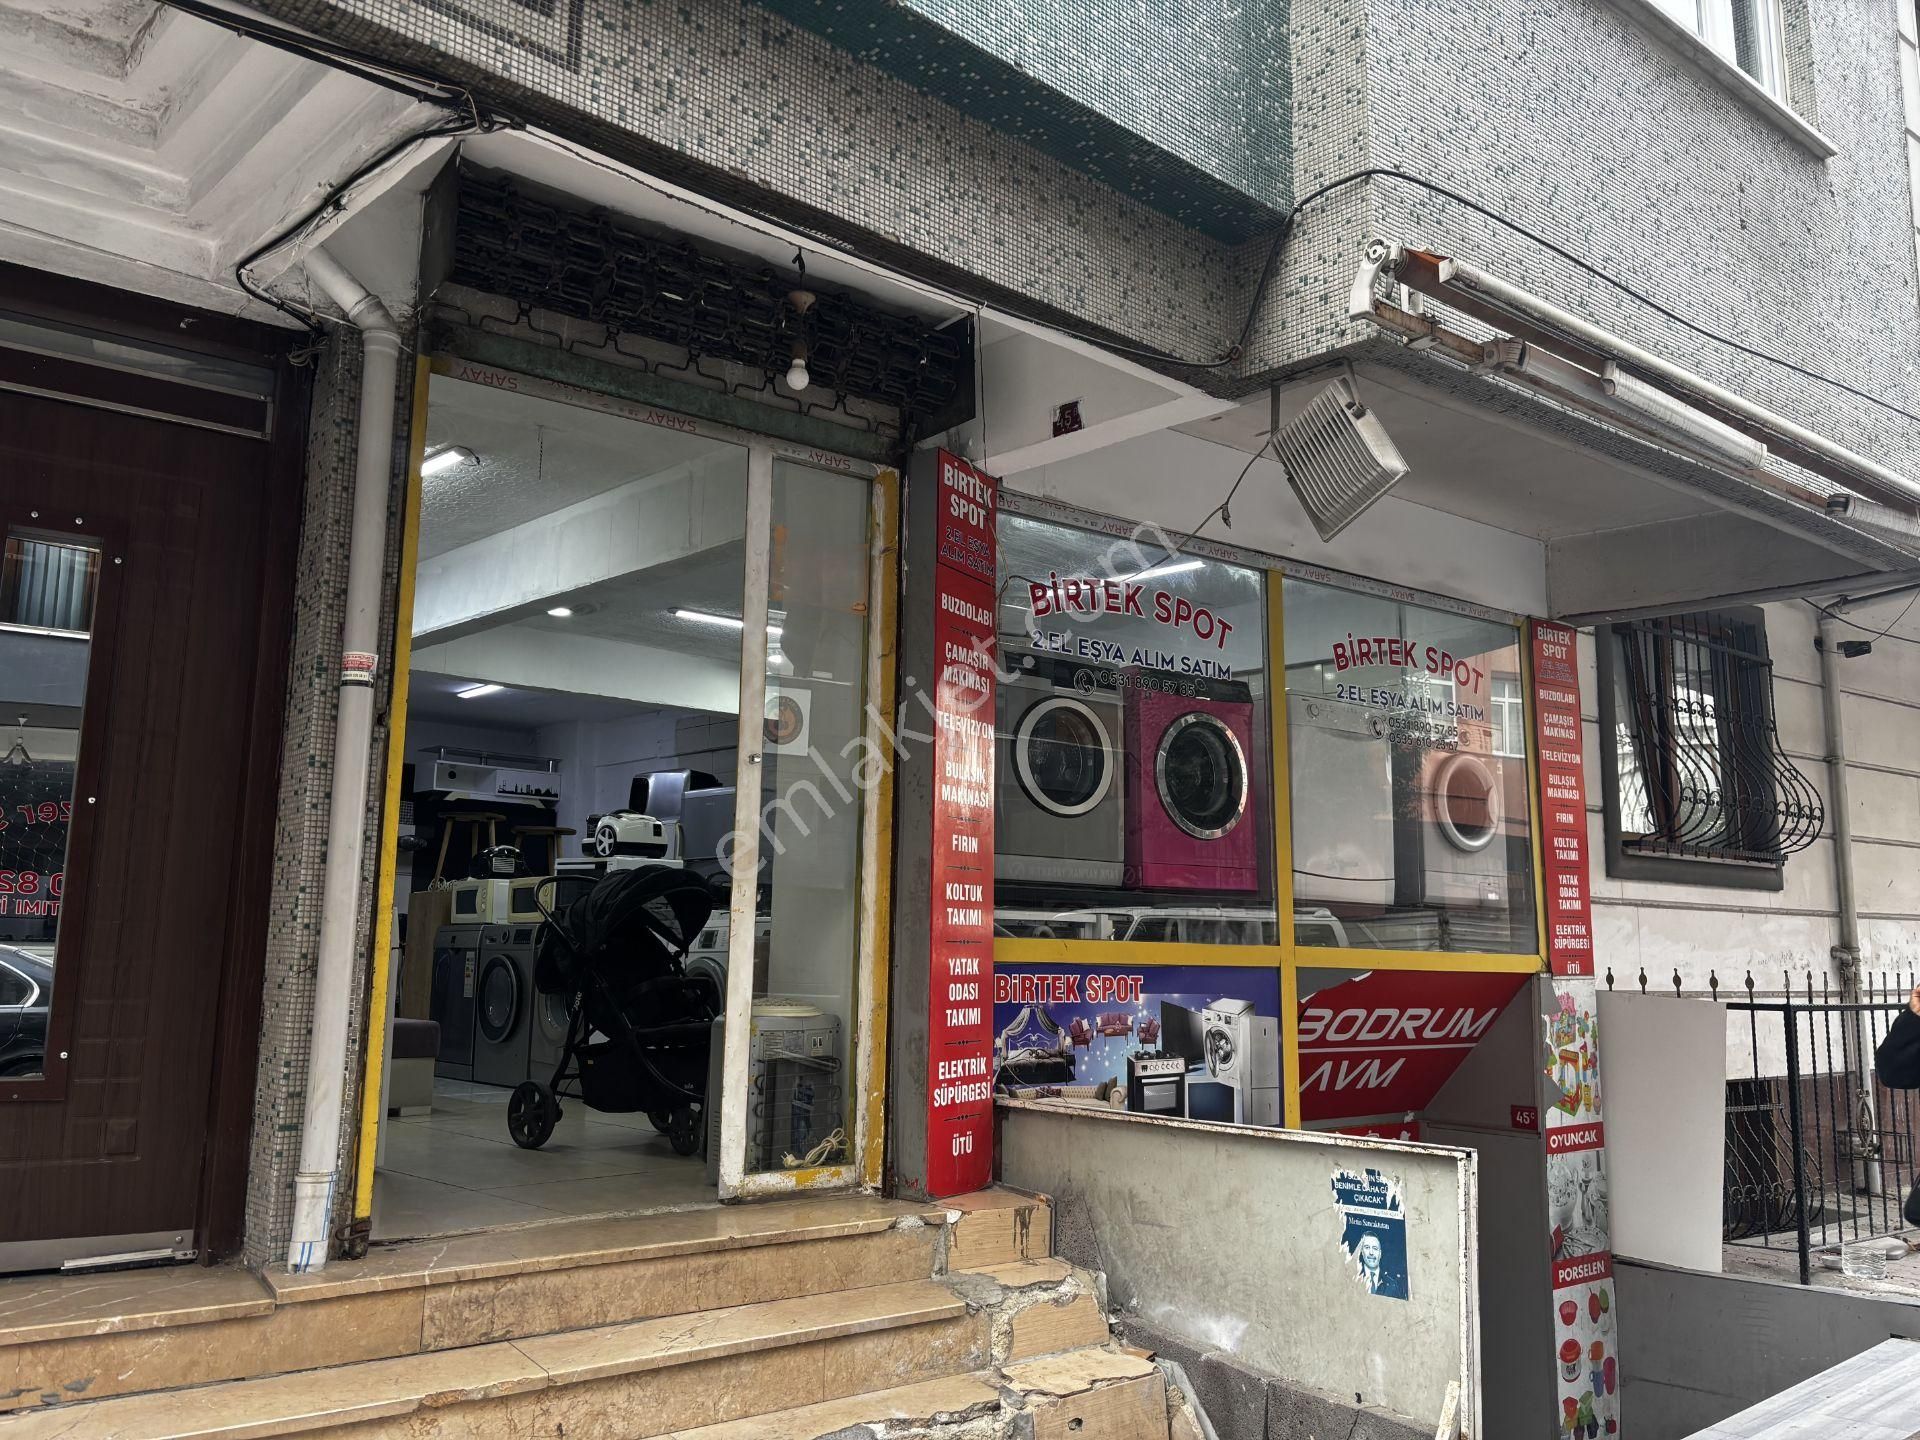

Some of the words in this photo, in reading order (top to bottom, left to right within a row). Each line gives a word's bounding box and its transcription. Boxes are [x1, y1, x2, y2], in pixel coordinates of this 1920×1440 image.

[943, 462, 992, 509] BİRTEK
[950, 495, 987, 530] SPOT
[941, 592, 993, 628] BUZDOLABI
[1028, 571, 1146, 618] BİRTEK
[1153, 590, 1233, 650] SPOT
[1538, 624, 1571, 645] BİRTEK
[945, 642, 989, 672] ÇAMAŞIR
[1031, 630, 1073, 655] 2.EL
[1078, 638, 1126, 663] EŞYA
[1131, 648, 1175, 672] ALIM
[1181, 656, 1232, 681] SATIM
[1543, 644, 1567, 660] SPOT
[1333, 632, 1418, 672] BİRTEK
[1425, 646, 1484, 695] SPOT
[943, 664, 990, 693] MAKİNASI
[1100, 670, 1130, 688] 0531
[1135, 674, 1159, 691] 890
[1163, 680, 1177, 695] 57
[1180, 683, 1195, 697] 85
[1336, 684, 1367, 703] 2.EL
[1371, 689, 1407, 710] EŞYA
[1410, 697, 1443, 715] ALIM
[1446, 703, 1484, 722] SATIM
[1540, 689, 1576, 704] BUZDOLABI
[937, 710, 994, 740] TELEVİZYON
[1388, 717, 1414, 732] 0531
[1414, 721, 1432, 735] 890
[1433, 724, 1446, 735] 57
[1446, 725, 1459, 738] 85
[1544, 712, 1574, 728] ÇAMAŞIR
[1388, 732, 1413, 746] 0535
[1544, 724, 1576, 740] MAKİNASI
[1542, 749, 1581, 764] TELEVİZYON
[945, 761, 986, 787] BULAŞIK
[1548, 773, 1576, 787] BULAŞIK
[941, 784, 989, 809] MAKİNASI
[1547, 785, 1580, 800] MAKİNASI
[1556, 813, 1573, 824] FIRIN
[952, 835, 978, 854] FIRIN
[1554, 837, 1578, 849] KOLTUK
[1556, 850, 1579, 860] TAKIMI
[1558, 874, 1579, 885] YATAK
[946, 883, 983, 902] KOLTUK
[1560, 887, 1579, 898] ODASI
[1559, 899, 1581, 910] TAKIMI
[946, 908, 982, 927] TAKIMI
[1556, 922, 1586, 935] ELEKTRİK
[1554, 936, 1589, 949] SÜPÜRGESİ
[948, 958, 979, 975] YATAK
[1567, 962, 1580, 974] ÜTÜ
[948, 982, 979, 1001] ODASI
[1086, 975, 1144, 1003] SPOT
[946, 1007, 981, 1027] TAKIMI
[1298, 1007, 1498, 1042] BODRUM
[938, 1053, 987, 1080] ELEKTRİK
[1300, 1058, 1406, 1093] AVM
[934, 1076, 990, 1107] SÜPÜRGESİ
[952, 1131, 973, 1157] ÜTÜ
[1549, 1130, 1597, 1148] OYUNCAK
[1559, 1260, 1605, 1283] PORSELEN
